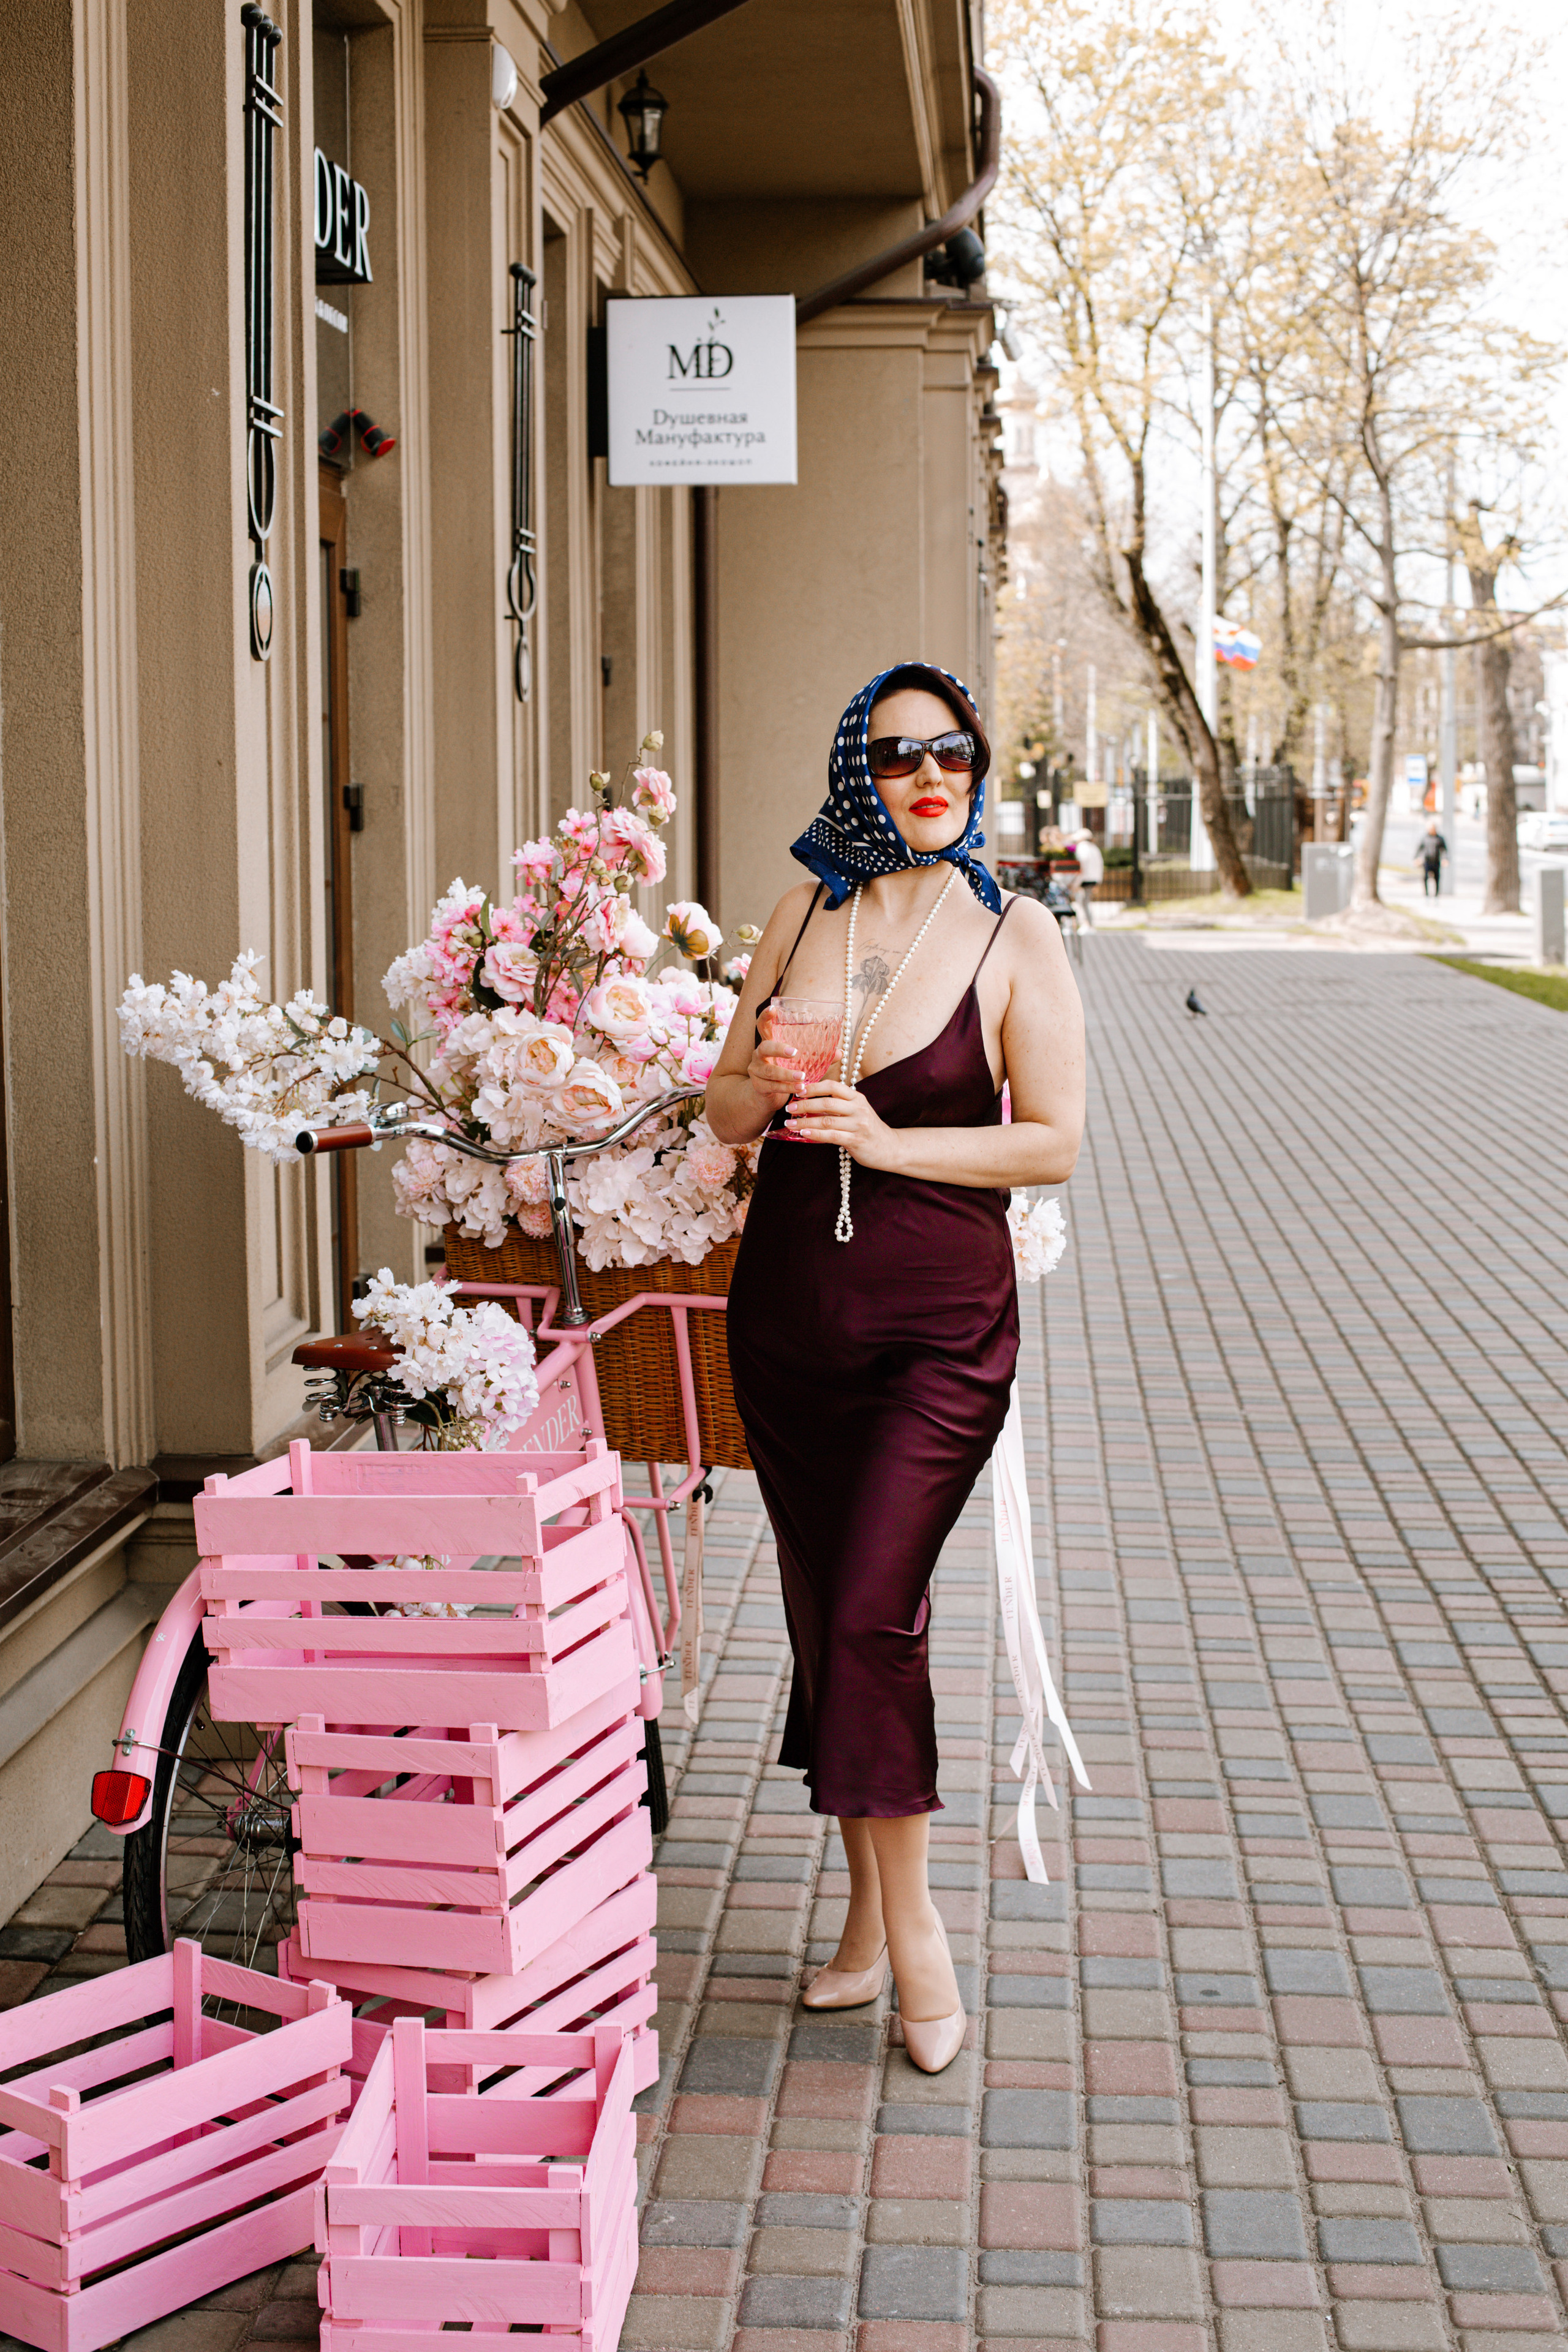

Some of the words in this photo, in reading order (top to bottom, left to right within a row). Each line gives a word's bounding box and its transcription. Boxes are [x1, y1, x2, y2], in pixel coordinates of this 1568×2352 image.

[314, 146, 374, 282] DER
[668, 344, 733, 379] MD
[635, 428, 766, 449] Мануфактура
